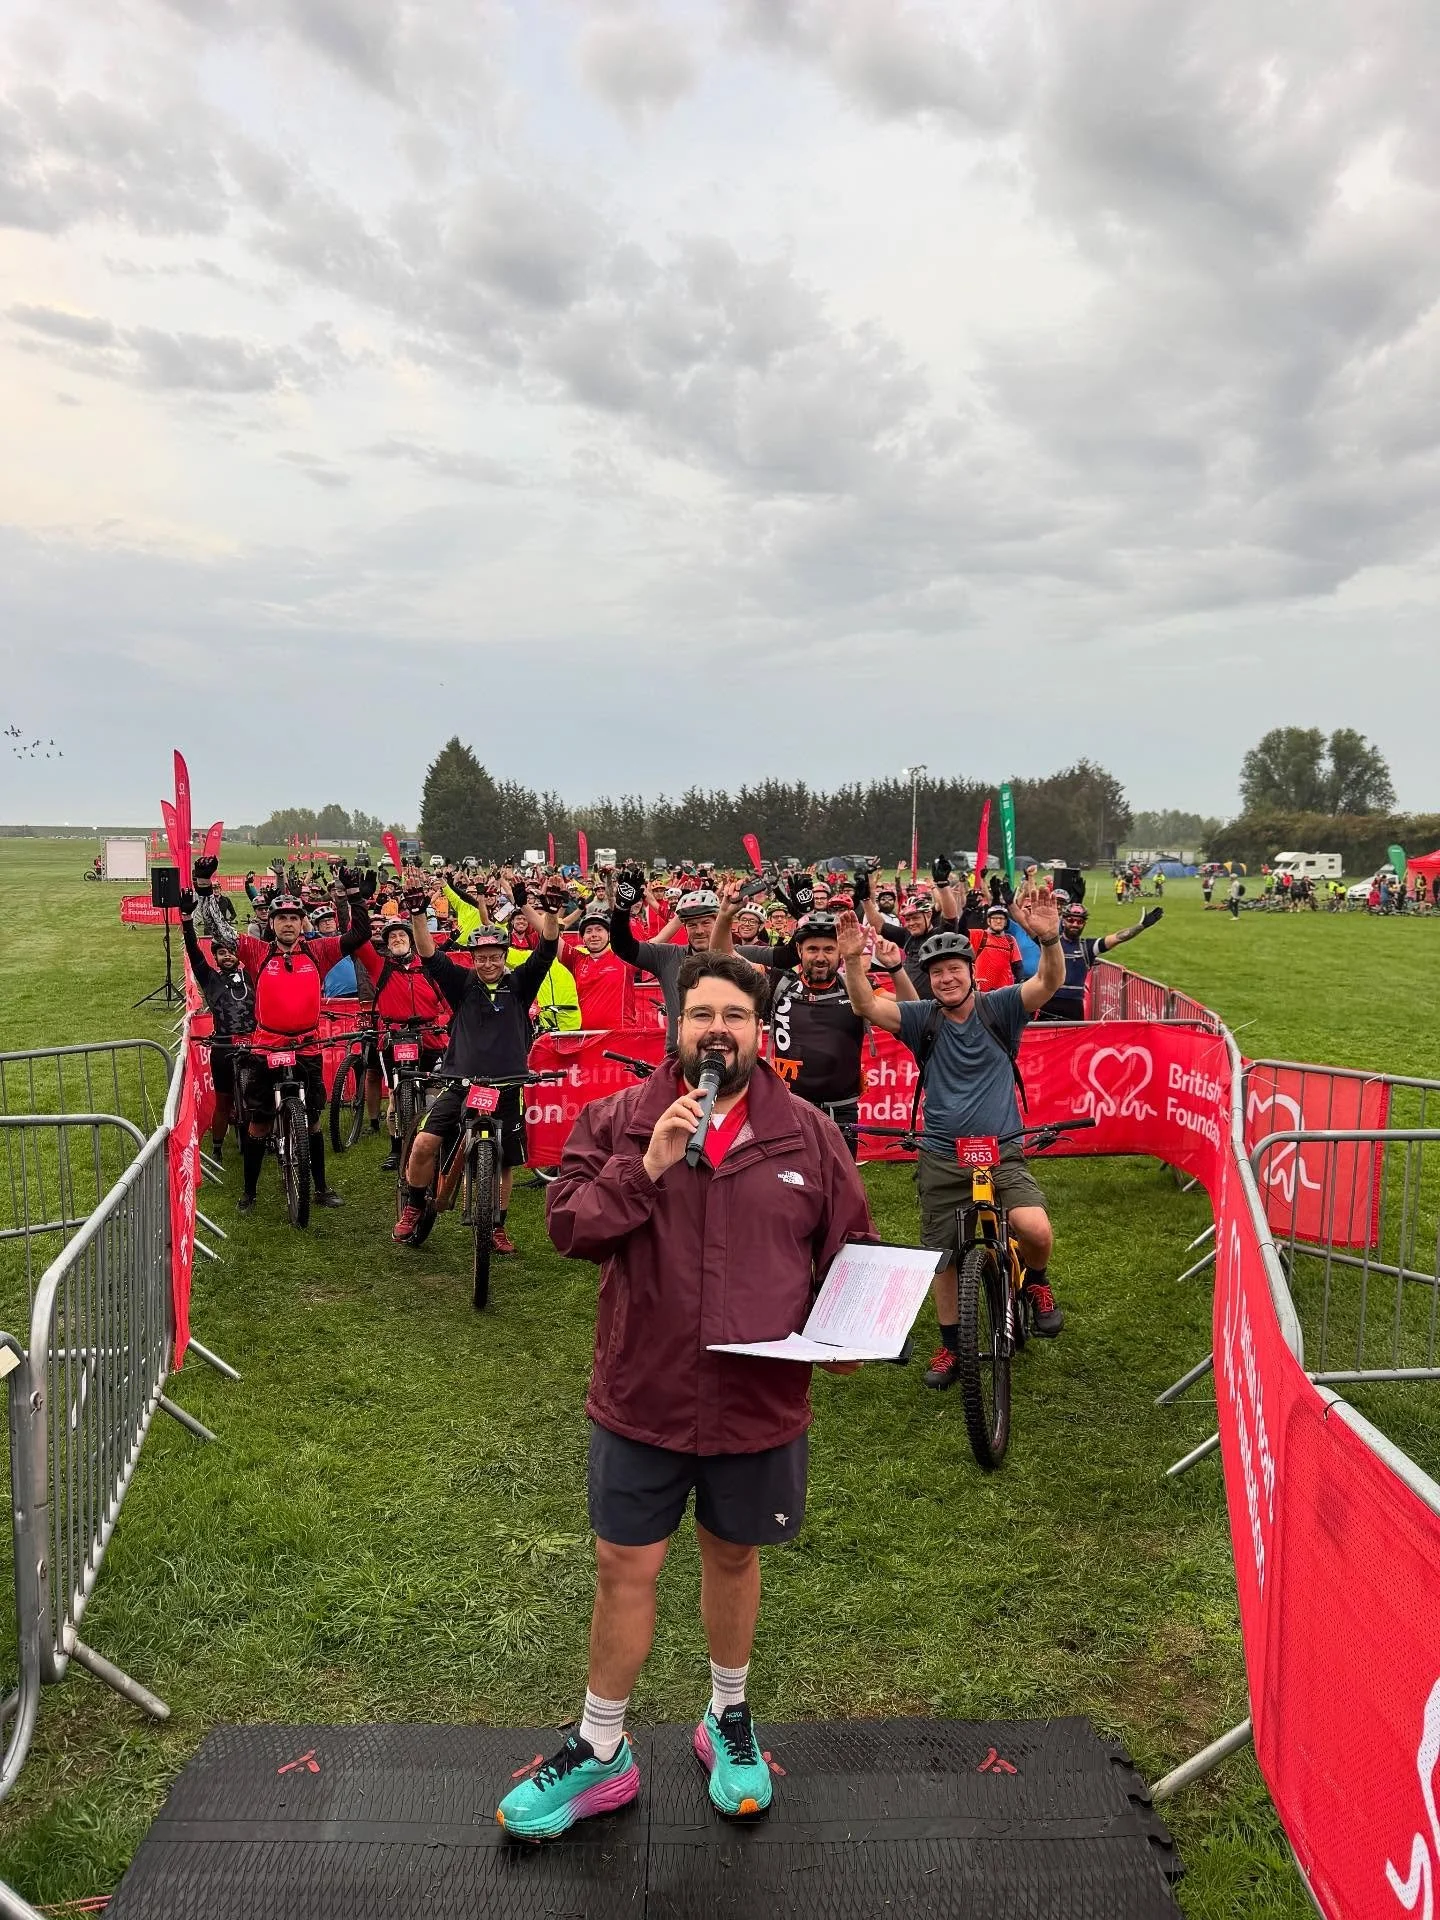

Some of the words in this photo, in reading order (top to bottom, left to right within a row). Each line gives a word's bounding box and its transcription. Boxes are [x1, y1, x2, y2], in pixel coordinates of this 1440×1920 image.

[1168, 1062, 1221, 1104] British
[471, 1096, 493, 1108] 2329
[963, 1151, 993, 1163] 2853
